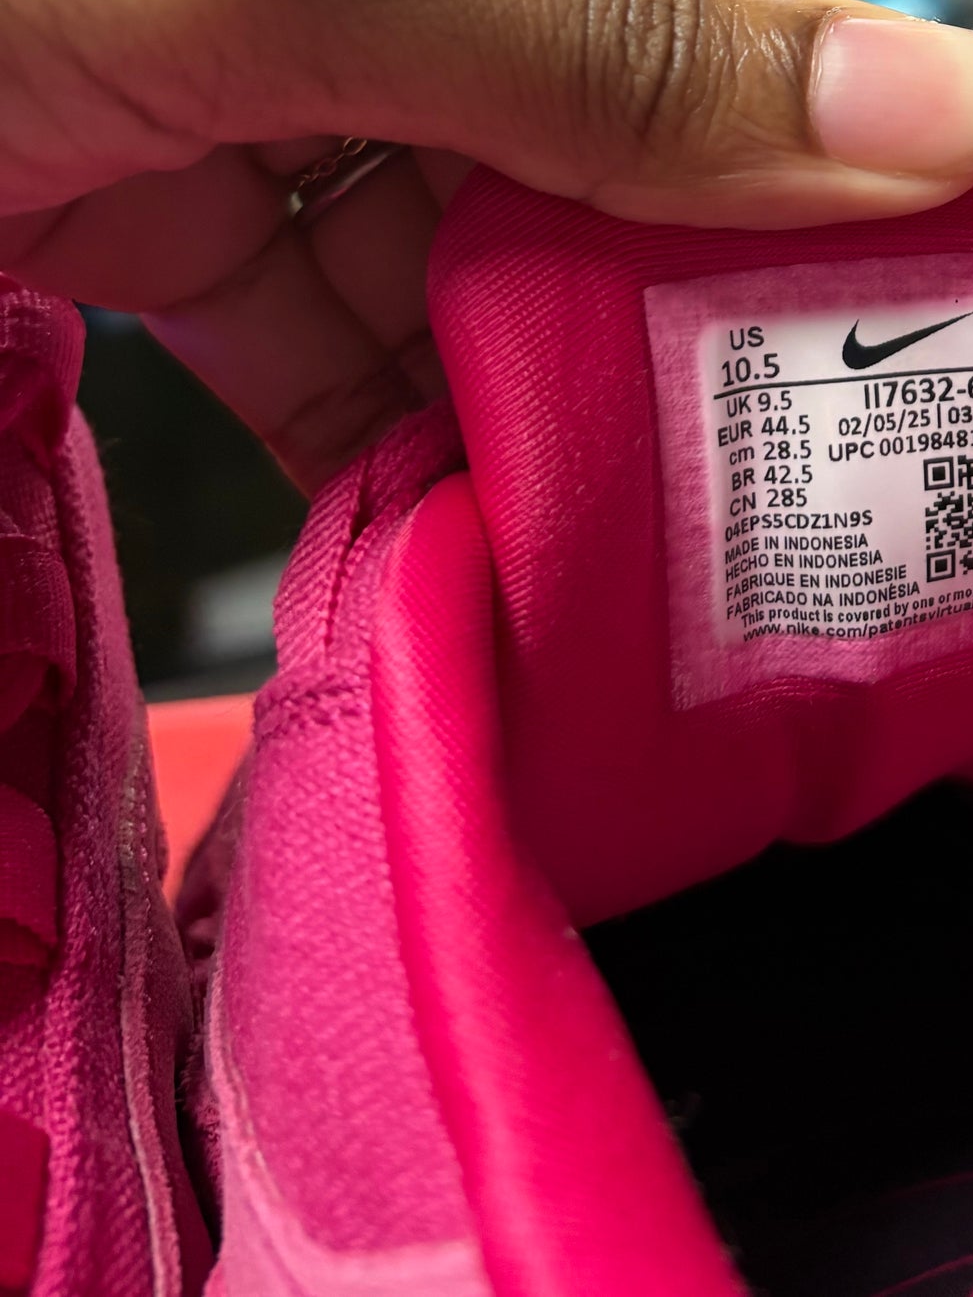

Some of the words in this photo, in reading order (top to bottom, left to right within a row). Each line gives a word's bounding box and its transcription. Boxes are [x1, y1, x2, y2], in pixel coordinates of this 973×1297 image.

[730, 326, 764, 350] US
[721, 353, 780, 387] 10.5
[727, 394, 752, 418] UK
[758, 390, 792, 412] 9.5
[718, 420, 753, 447] EUR
[761, 415, 810, 436] 44.5
[838, 409, 931, 437] 02/05/25
[729, 446, 755, 465] cm
[763, 440, 812, 460] 28.5
[828, 441, 875, 462] UPC
[731, 468, 755, 491] BR
[764, 465, 813, 484] 42.5
[729, 492, 757, 517] CN
[766, 488, 808, 508] 285
[725, 510, 873, 542] 04EPS5CDZ1N9S
[725, 537, 760, 564] MADE
[764, 536, 779, 550] IN
[784, 533, 869, 551] INDONESIA
[725, 554, 769, 583] HECHO
[774, 553, 794, 568] EN
[799, 550, 883, 569] INDONESIA
[726, 573, 795, 602] FABRIQUE
[800, 574, 820, 588] EN
[825, 565, 907, 588] INDONESIE
[726, 591, 808, 620] FABRICADO
[812, 593, 834, 607] NA
[839, 581, 920, 607] INDONÉSIA
[740, 608, 765, 628] This
[769, 607, 820, 625] product
[823, 611, 833, 623] is
[838, 604, 890, 623] covered
[894, 601, 910, 617] by
[912, 595, 935, 611] one
[938, 593, 951, 604] or
